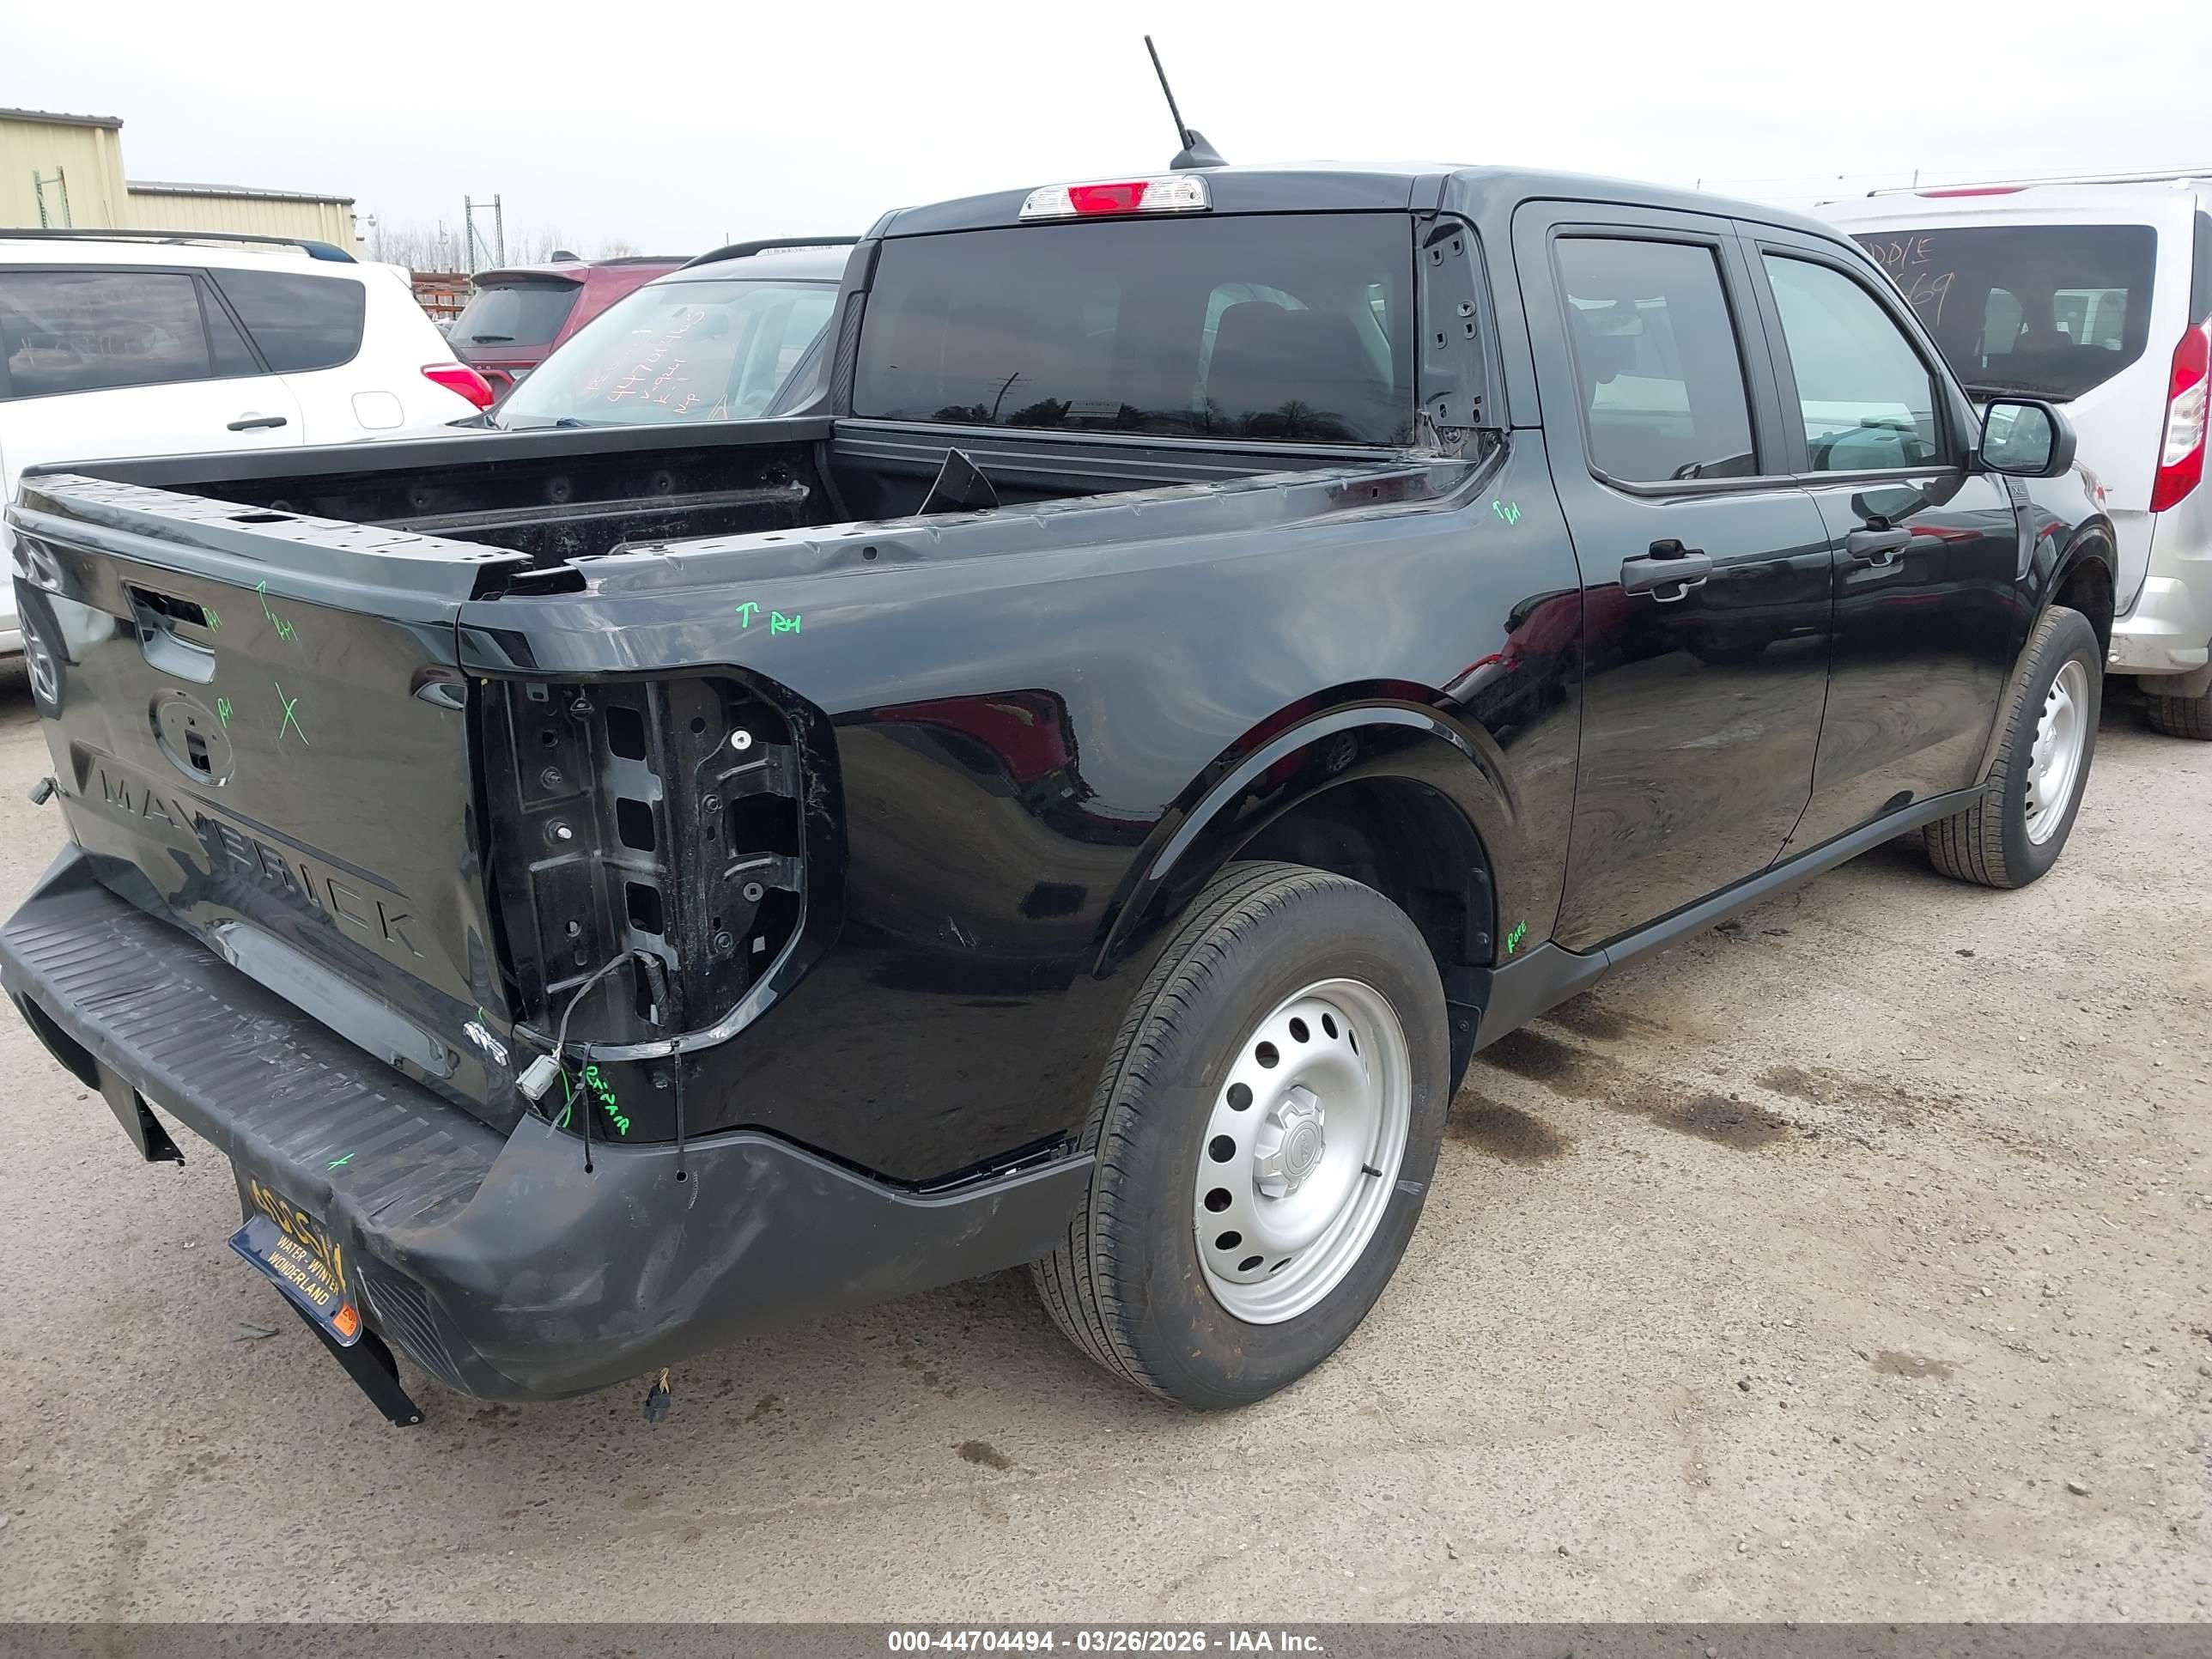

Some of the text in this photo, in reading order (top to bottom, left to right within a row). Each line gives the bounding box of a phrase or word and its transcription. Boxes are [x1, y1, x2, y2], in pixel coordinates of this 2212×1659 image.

[1857, 236, 1936, 270] DDIE
[771, 610, 802, 636] RH
[100, 769, 425, 958] MAVERICK
[267, 1250, 331, 1306] WONDERLAND
[276, 1234, 307, 1264] WATER
[307, 1257, 340, 1296] WINTER
